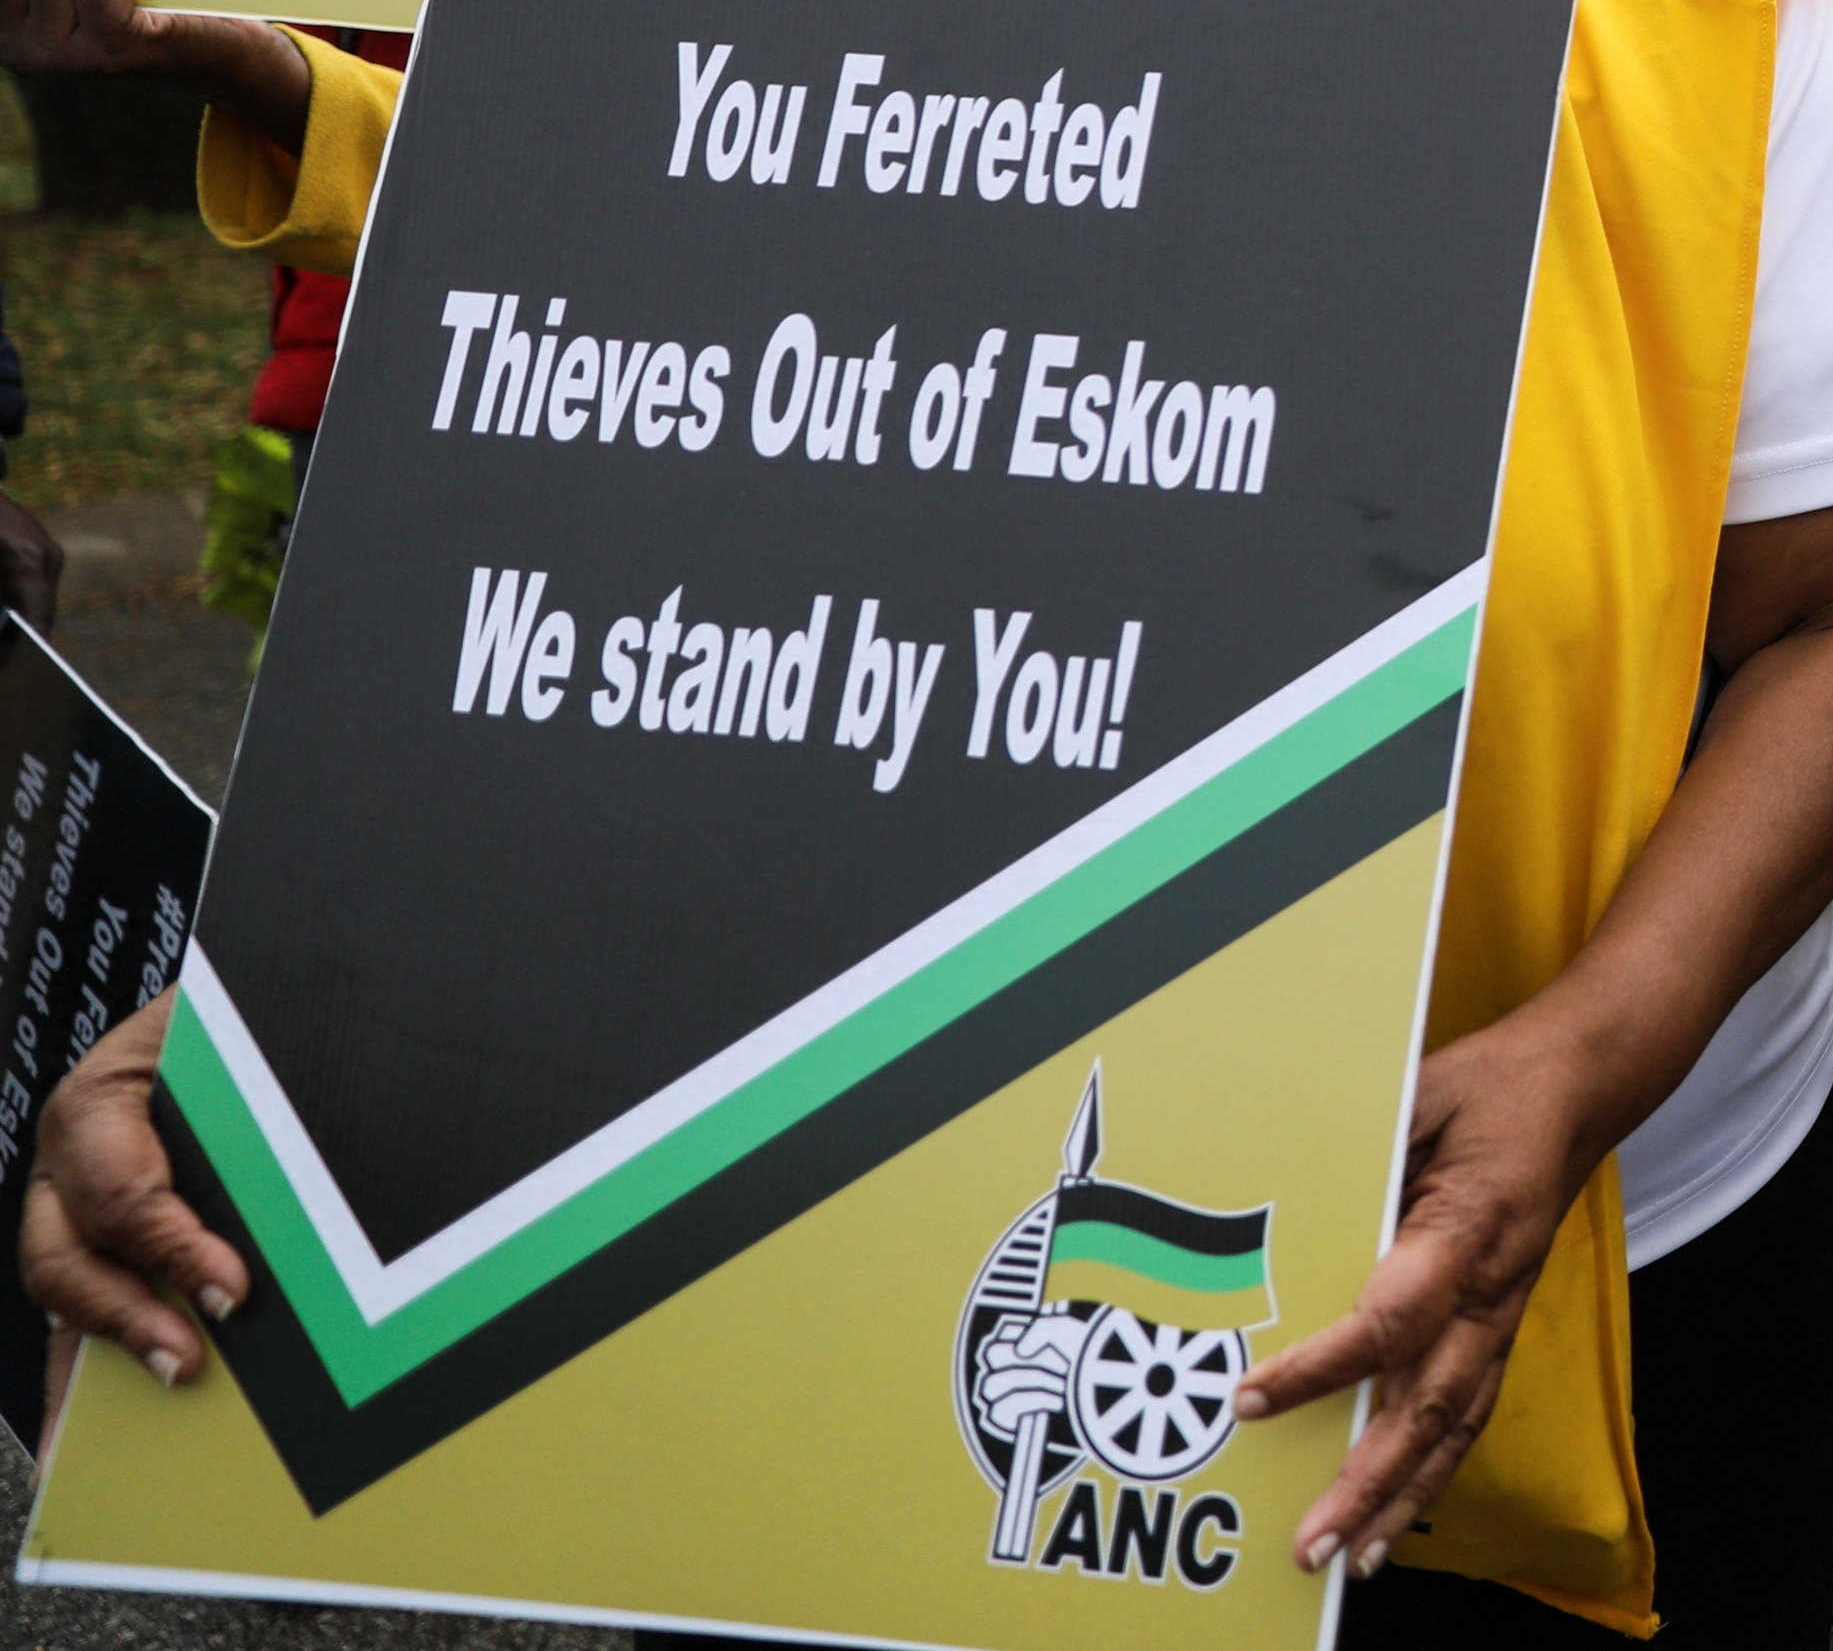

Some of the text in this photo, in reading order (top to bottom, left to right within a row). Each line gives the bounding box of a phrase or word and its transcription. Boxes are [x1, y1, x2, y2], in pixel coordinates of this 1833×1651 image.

[668, 42, 1161, 208] You Ferreted
[432, 291, 1275, 493] Thieves Out of Eskom
[453, 568, 1142, 792] We stand by You!
[14, 751, 48, 821] We
[45, 750, 101, 922] Thieves
[25, 926, 63, 1017] Out
[87, 895, 129, 984] You
[13, 1014, 38, 1080] of
[1040, 1480, 1239, 1587] ANC
